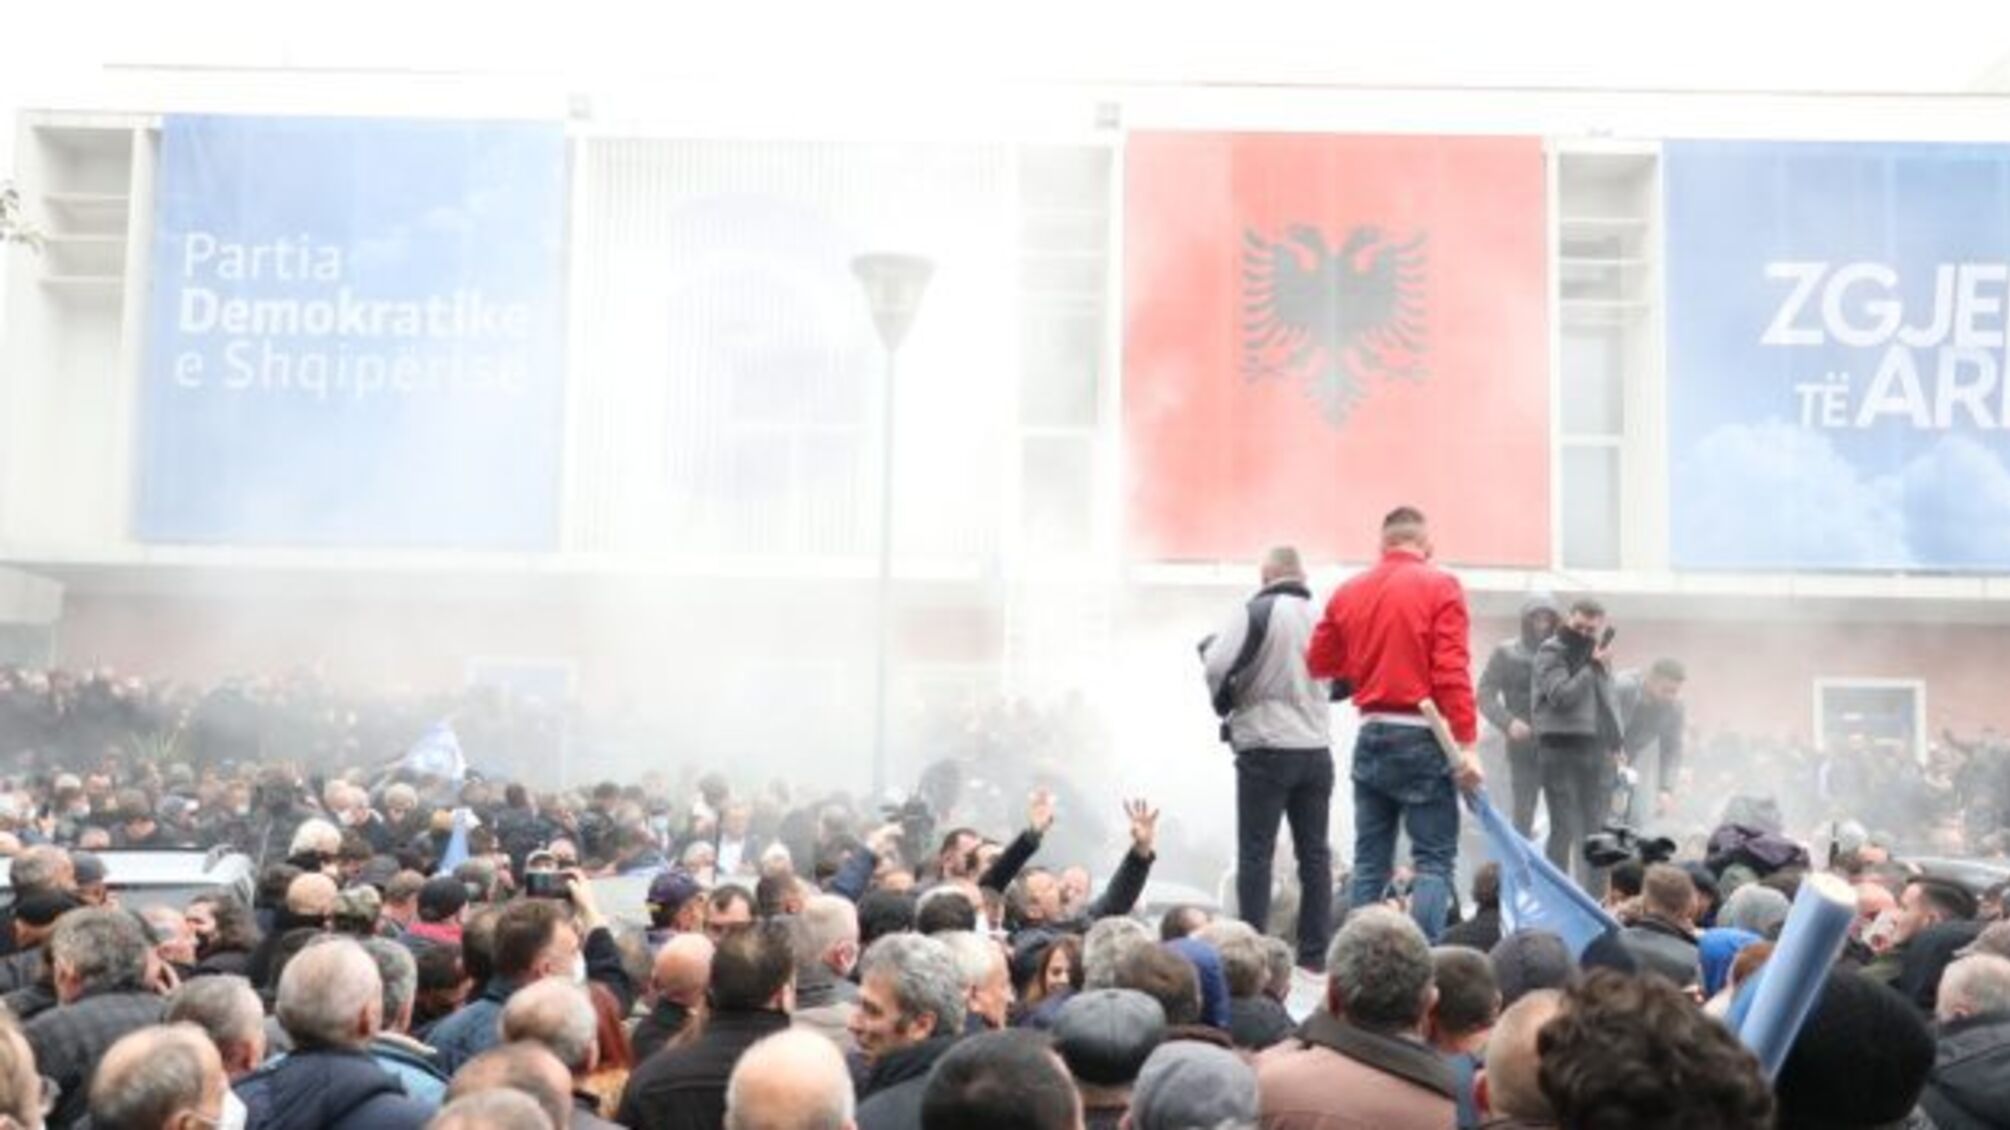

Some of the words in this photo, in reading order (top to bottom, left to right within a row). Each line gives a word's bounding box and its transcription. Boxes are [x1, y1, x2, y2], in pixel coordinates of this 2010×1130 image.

[184, 232, 342, 281] Partia
[179, 286, 530, 338] Demokratike
[1760, 261, 2010, 348] ZGJE
[175, 350, 205, 388] e
[1795, 371, 1850, 428] TË
[1854, 345, 2010, 429] AR
